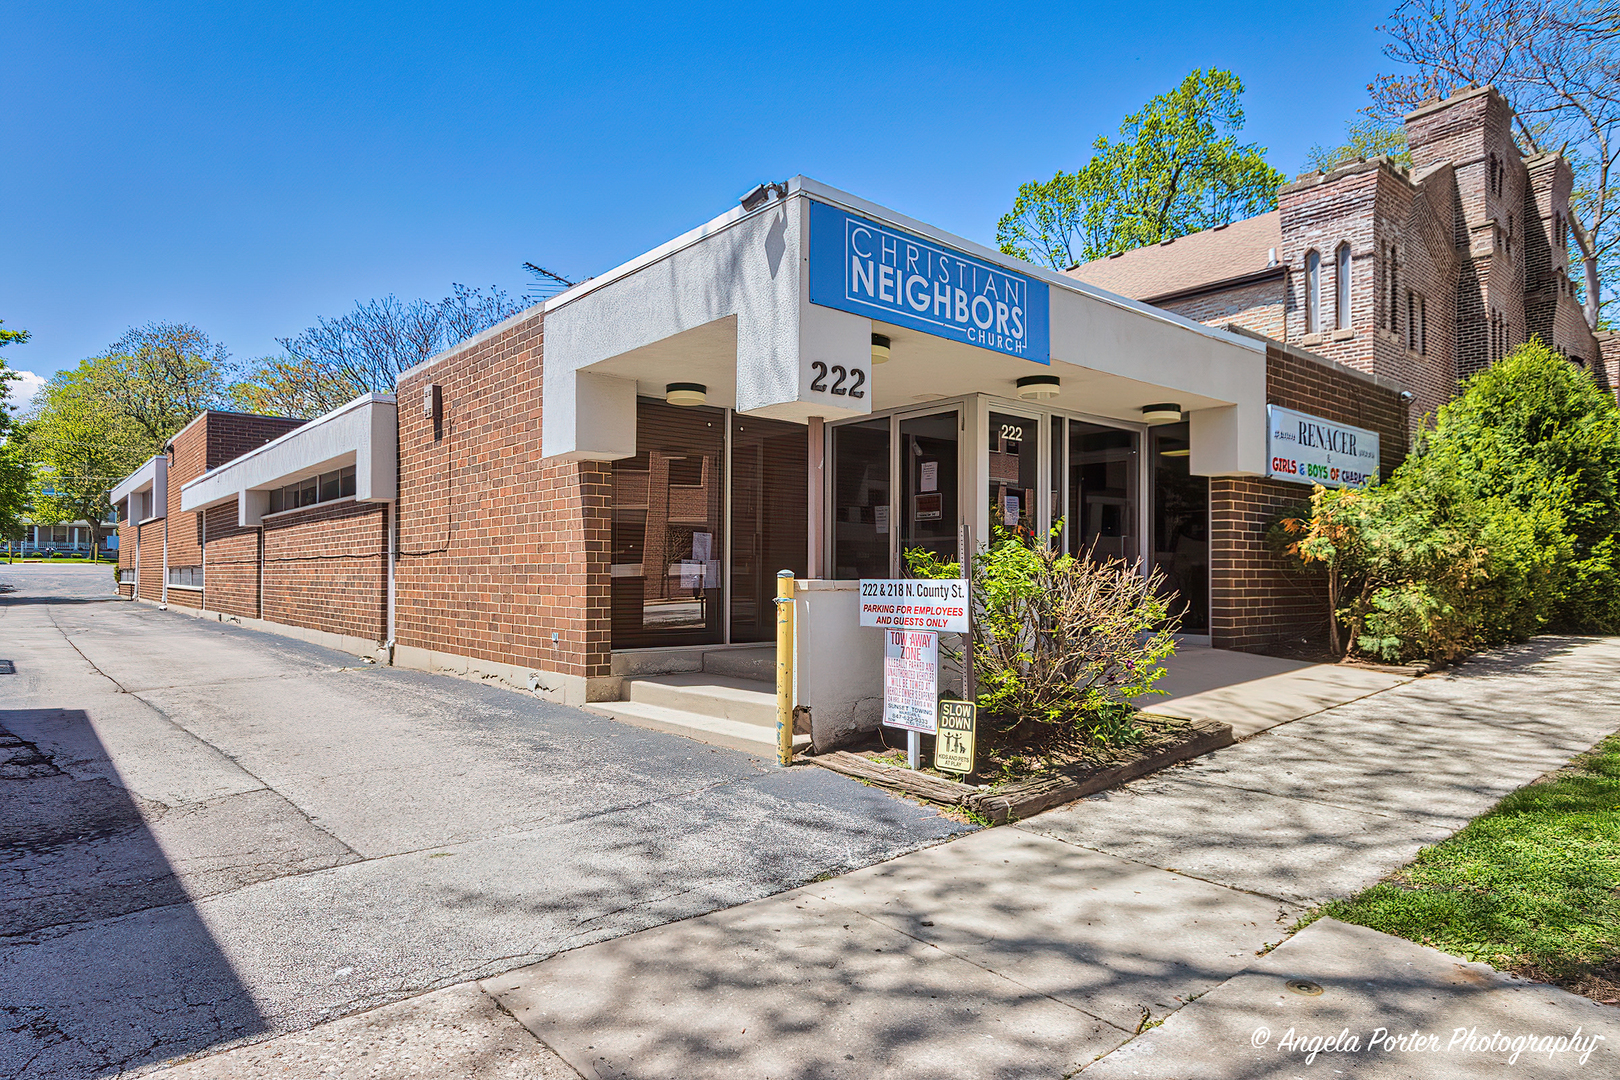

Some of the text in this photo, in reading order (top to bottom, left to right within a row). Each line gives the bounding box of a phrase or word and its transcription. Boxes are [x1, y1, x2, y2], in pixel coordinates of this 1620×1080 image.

[852, 227, 1019, 306] CHRISTIAN
[852, 255, 1024, 340] NEIGHBORS
[966, 327, 1022, 354] CHURCH
[810, 361, 866, 399] 222
[1001, 424, 1023, 442] 222
[1298, 421, 1357, 457] RENACER
[1272, 457, 1297, 474] GIRLS
[1299, 463, 1305, 475] &
[1307, 463, 1328, 479] BOYS
[1330, 468, 1340, 481] OF
[862, 583, 965, 601] 222 & 218 N. County St.
[863, 604, 963, 617] PARKING FOR EMPLOYEES
[876, 616, 948, 627] AND GUESTS ONLY
[891, 632, 931, 648] TOW AWAY
[901, 646, 921, 661] ZONE
[888, 702, 932, 716] SUNSET TOWING
[942, 703, 971, 718] SLOW
[941, 716, 971, 730] DOWN
